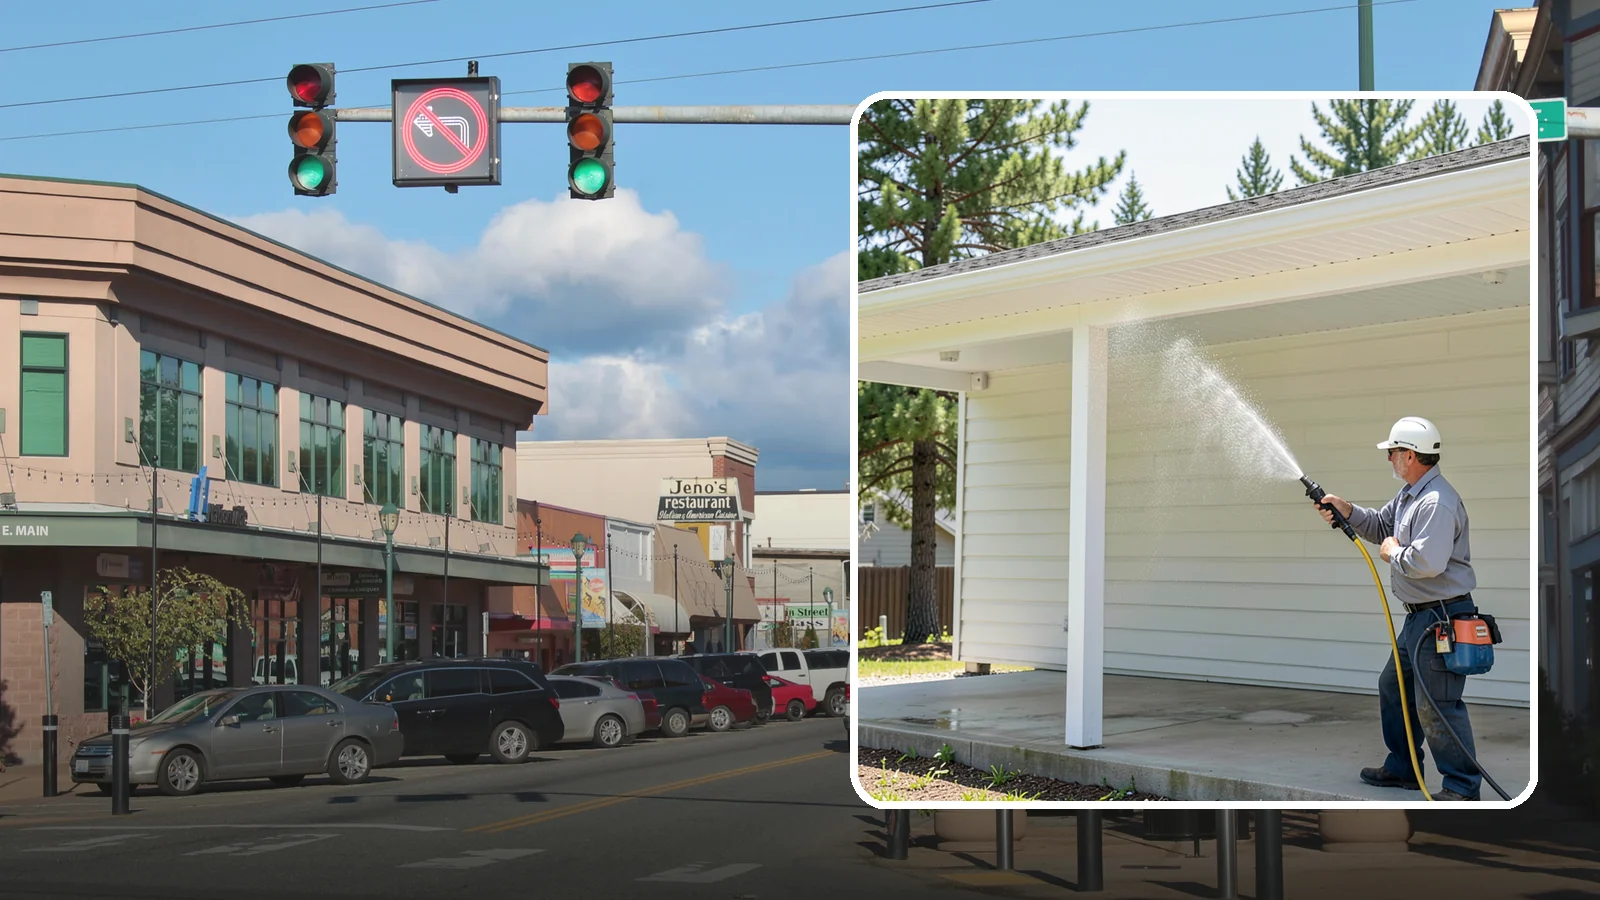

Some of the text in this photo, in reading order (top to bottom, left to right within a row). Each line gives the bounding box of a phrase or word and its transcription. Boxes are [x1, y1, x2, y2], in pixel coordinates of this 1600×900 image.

[670, 480, 727, 494] Jeno's
[665, 496, 731, 509] restaurant
[658, 510, 681, 519] Italian
[686, 510, 714, 519] American
[715, 510, 737, 519] Cuisine
[2, 525, 49, 536] E. MAIN
[798, 607, 828, 617] Street
[790, 619, 824, 627] lass
